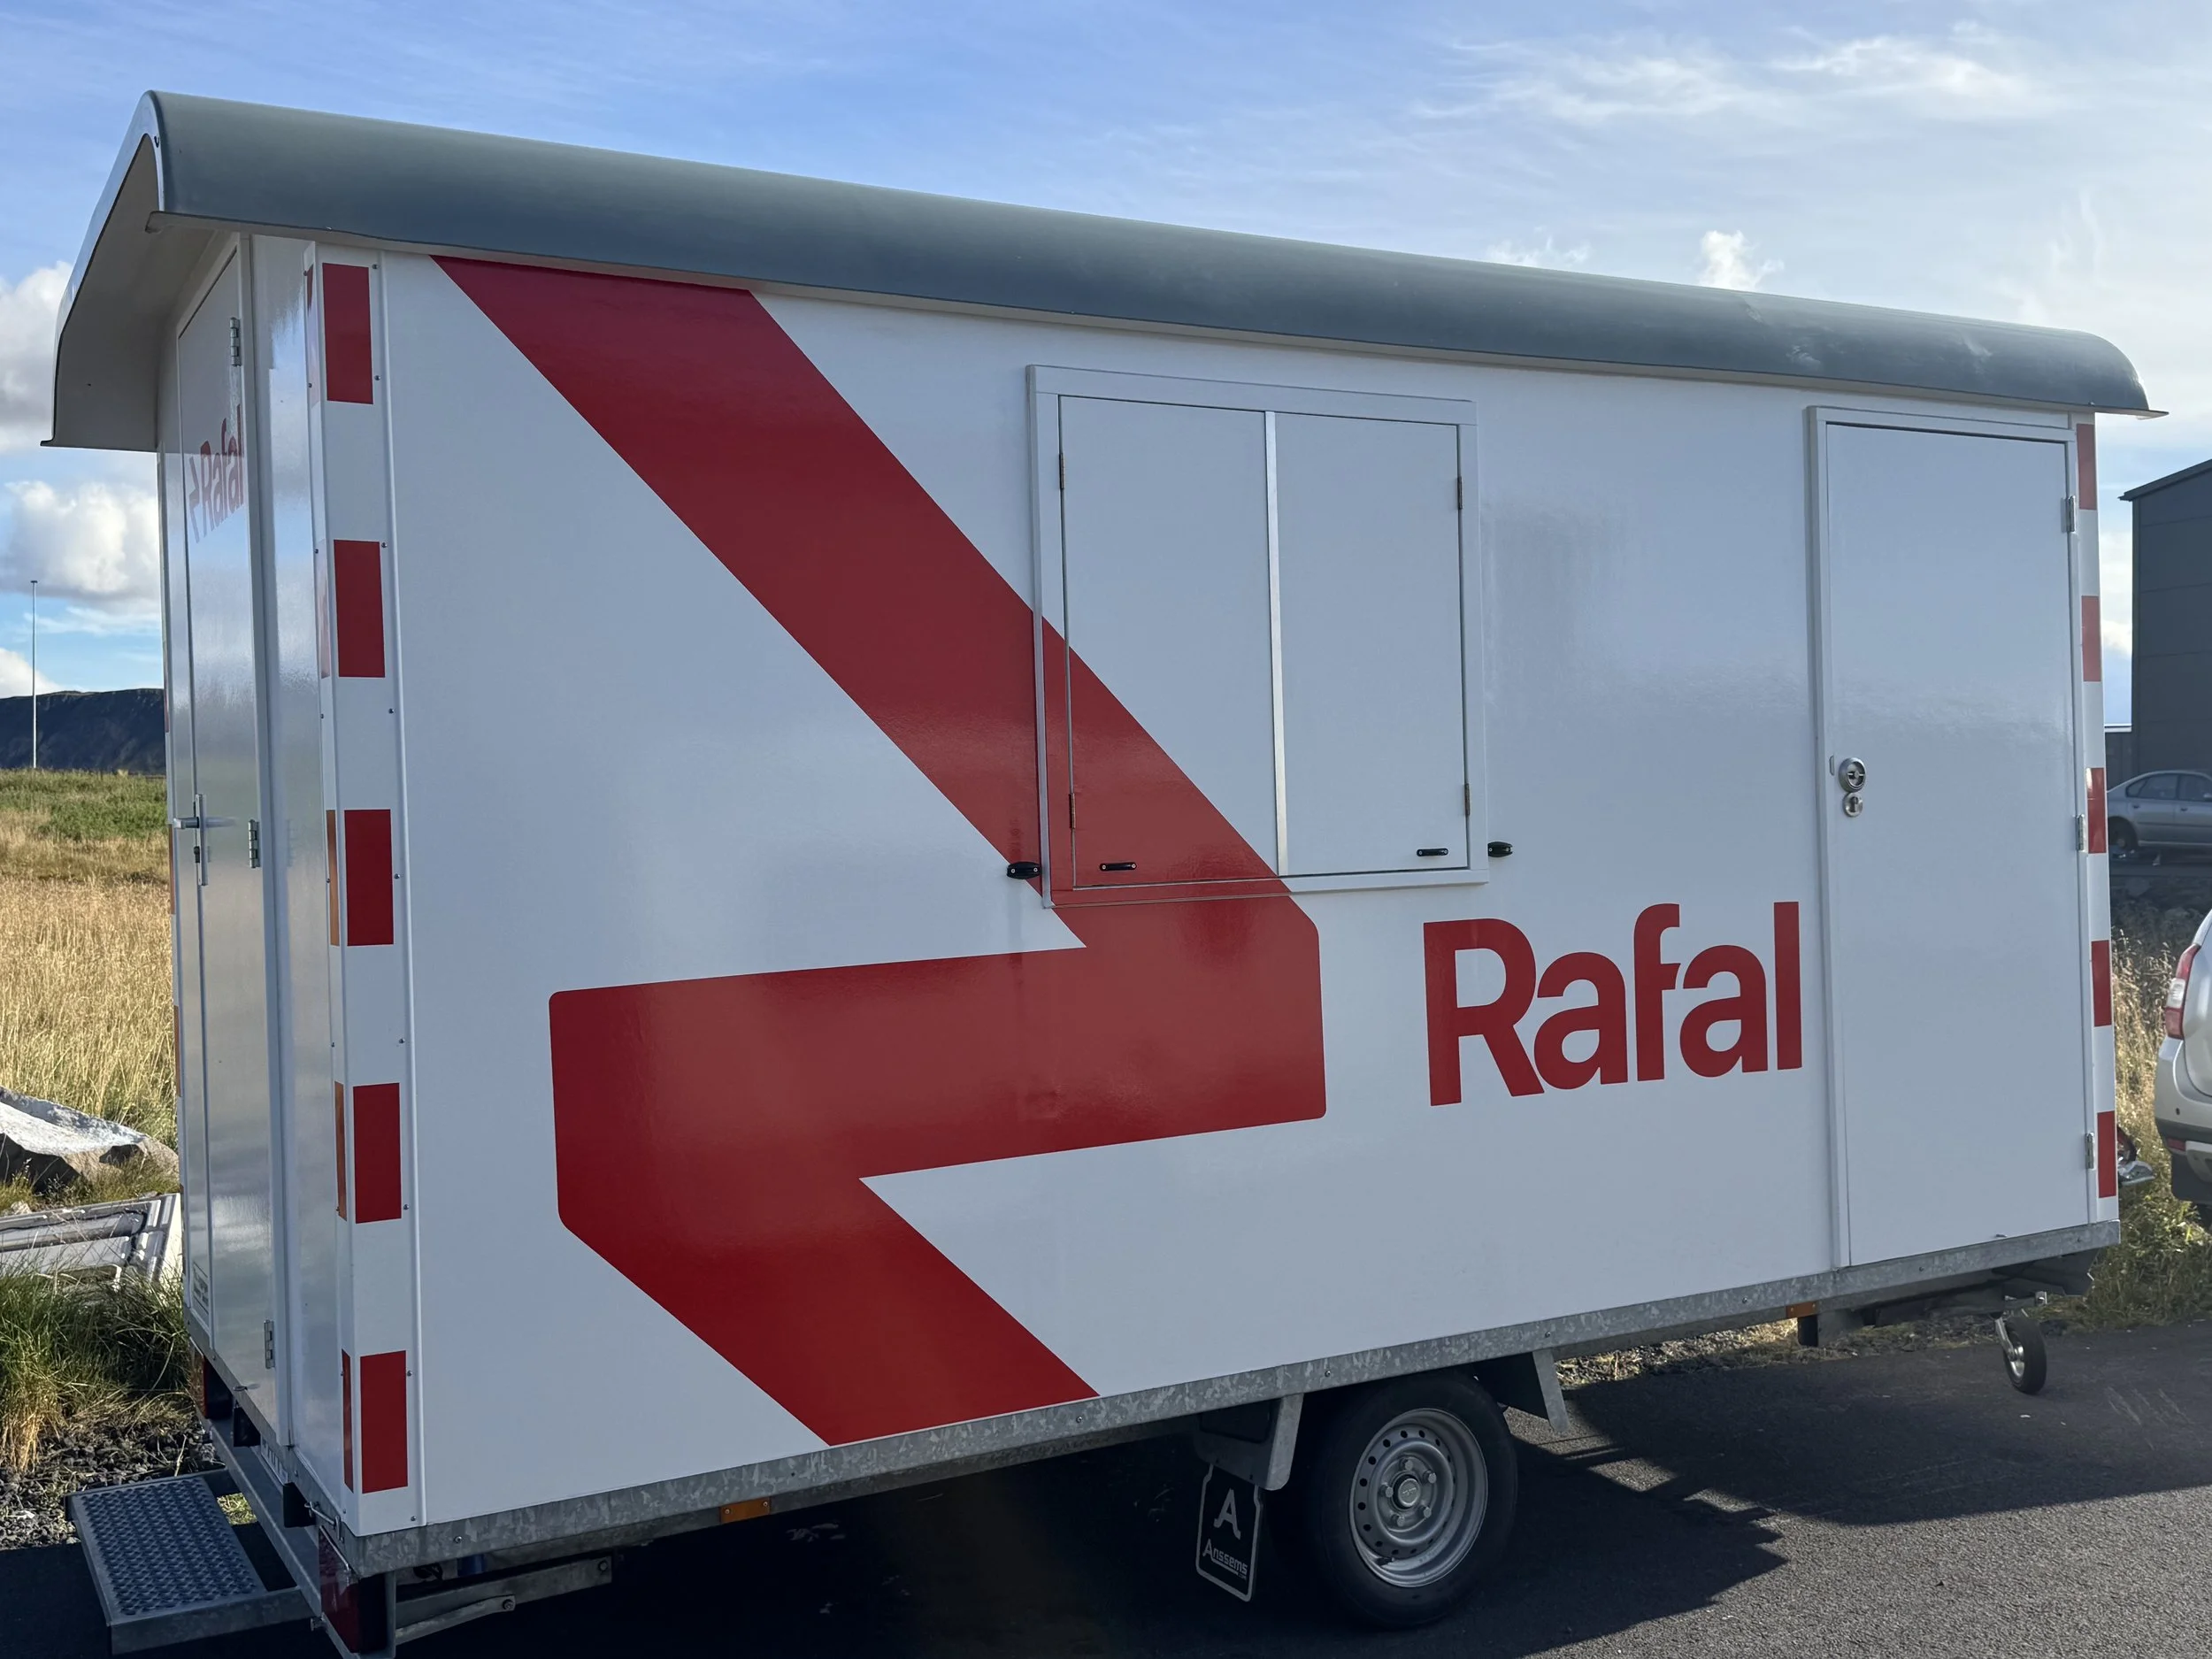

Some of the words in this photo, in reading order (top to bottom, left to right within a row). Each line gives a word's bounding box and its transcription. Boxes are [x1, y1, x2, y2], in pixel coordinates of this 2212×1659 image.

[200, 404, 244, 537] Rafal
[1423, 901, 1802, 1106] Rafal
[1202, 1539, 1248, 1575] Anssems
[1213, 1488, 1241, 1540] A
